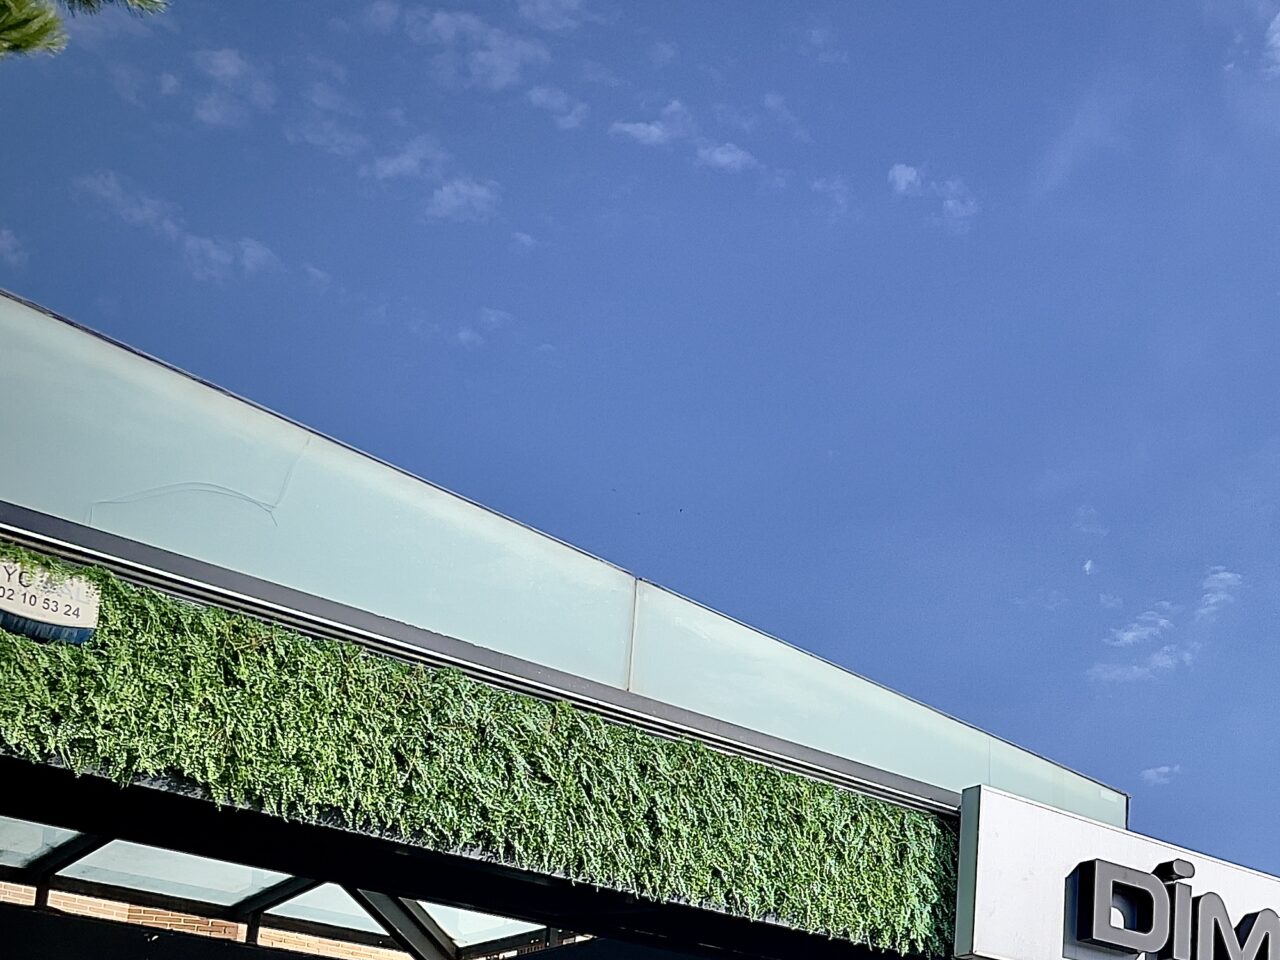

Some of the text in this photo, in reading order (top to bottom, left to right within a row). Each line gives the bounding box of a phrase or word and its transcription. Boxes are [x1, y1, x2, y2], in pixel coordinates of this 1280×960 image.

[21, 592, 37, 607] 10
[42, 598, 59, 613] 53
[63, 604, 80, 619] 24
